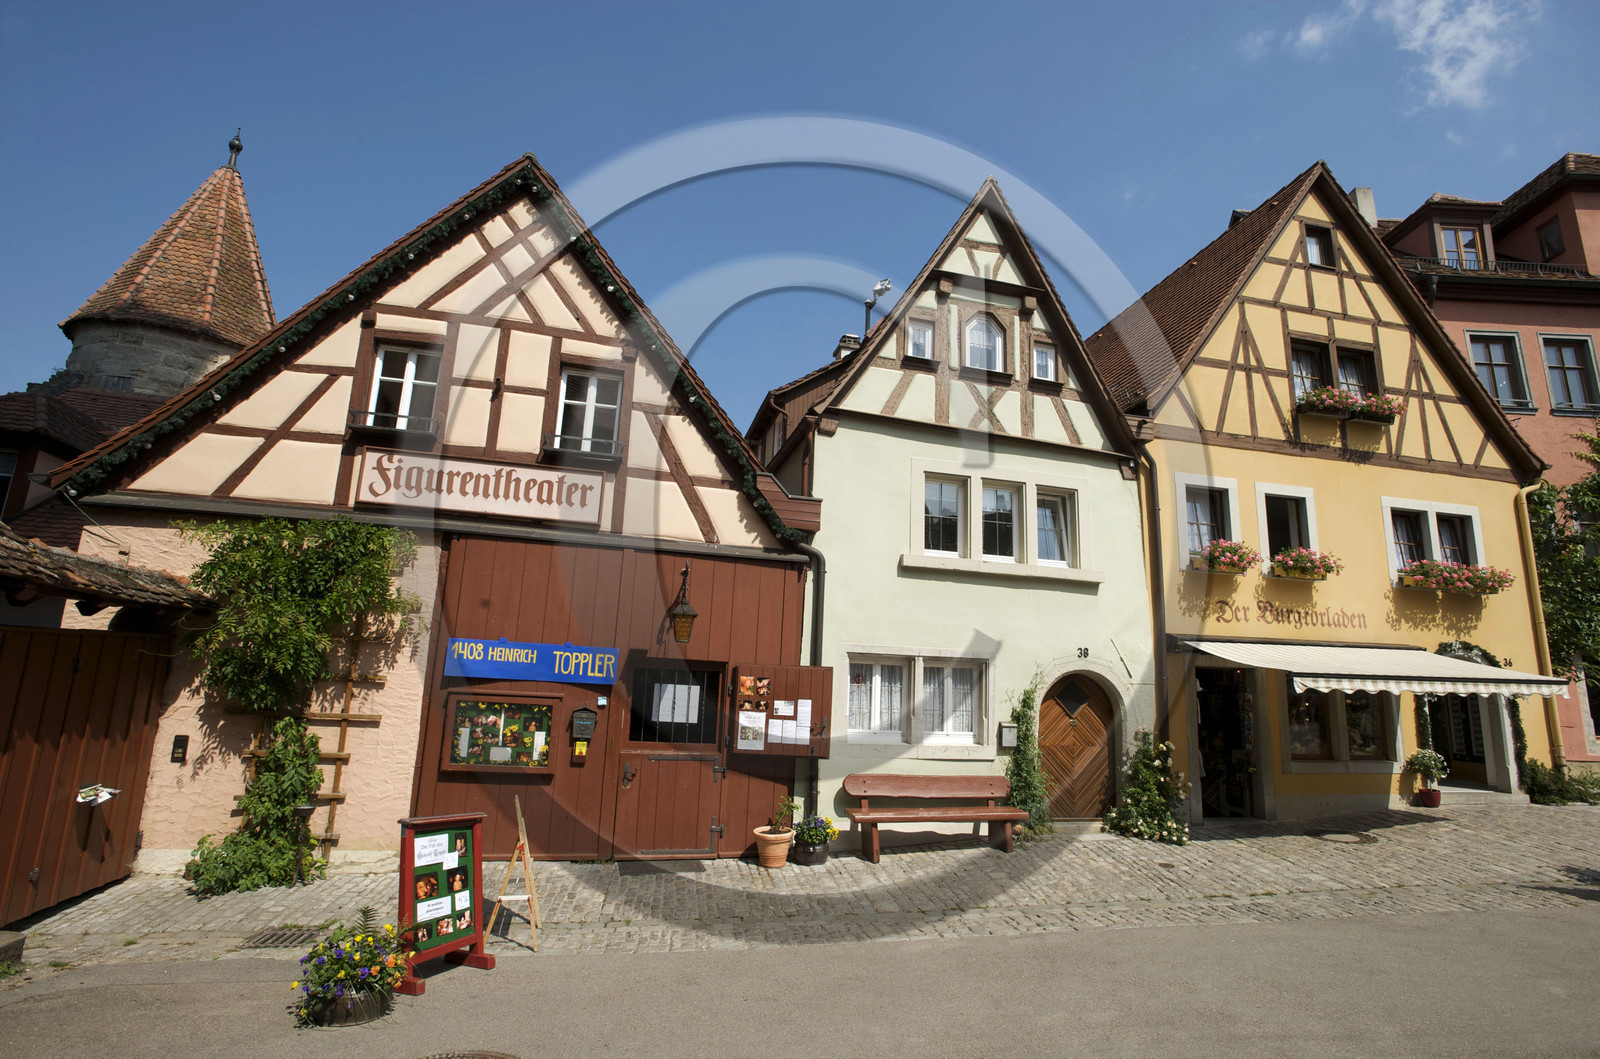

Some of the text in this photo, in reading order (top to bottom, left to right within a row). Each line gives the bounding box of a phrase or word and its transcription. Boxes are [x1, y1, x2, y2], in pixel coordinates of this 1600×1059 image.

[368, 453, 595, 509] Figurentheater
[1215, 599, 1368, 630] Der Burgtorladen
[451, 641, 615, 678] 1408 HEINRICH TOPPLER
[1077, 647, 1089, 659] 38
[1503, 657, 1513, 667] 36
